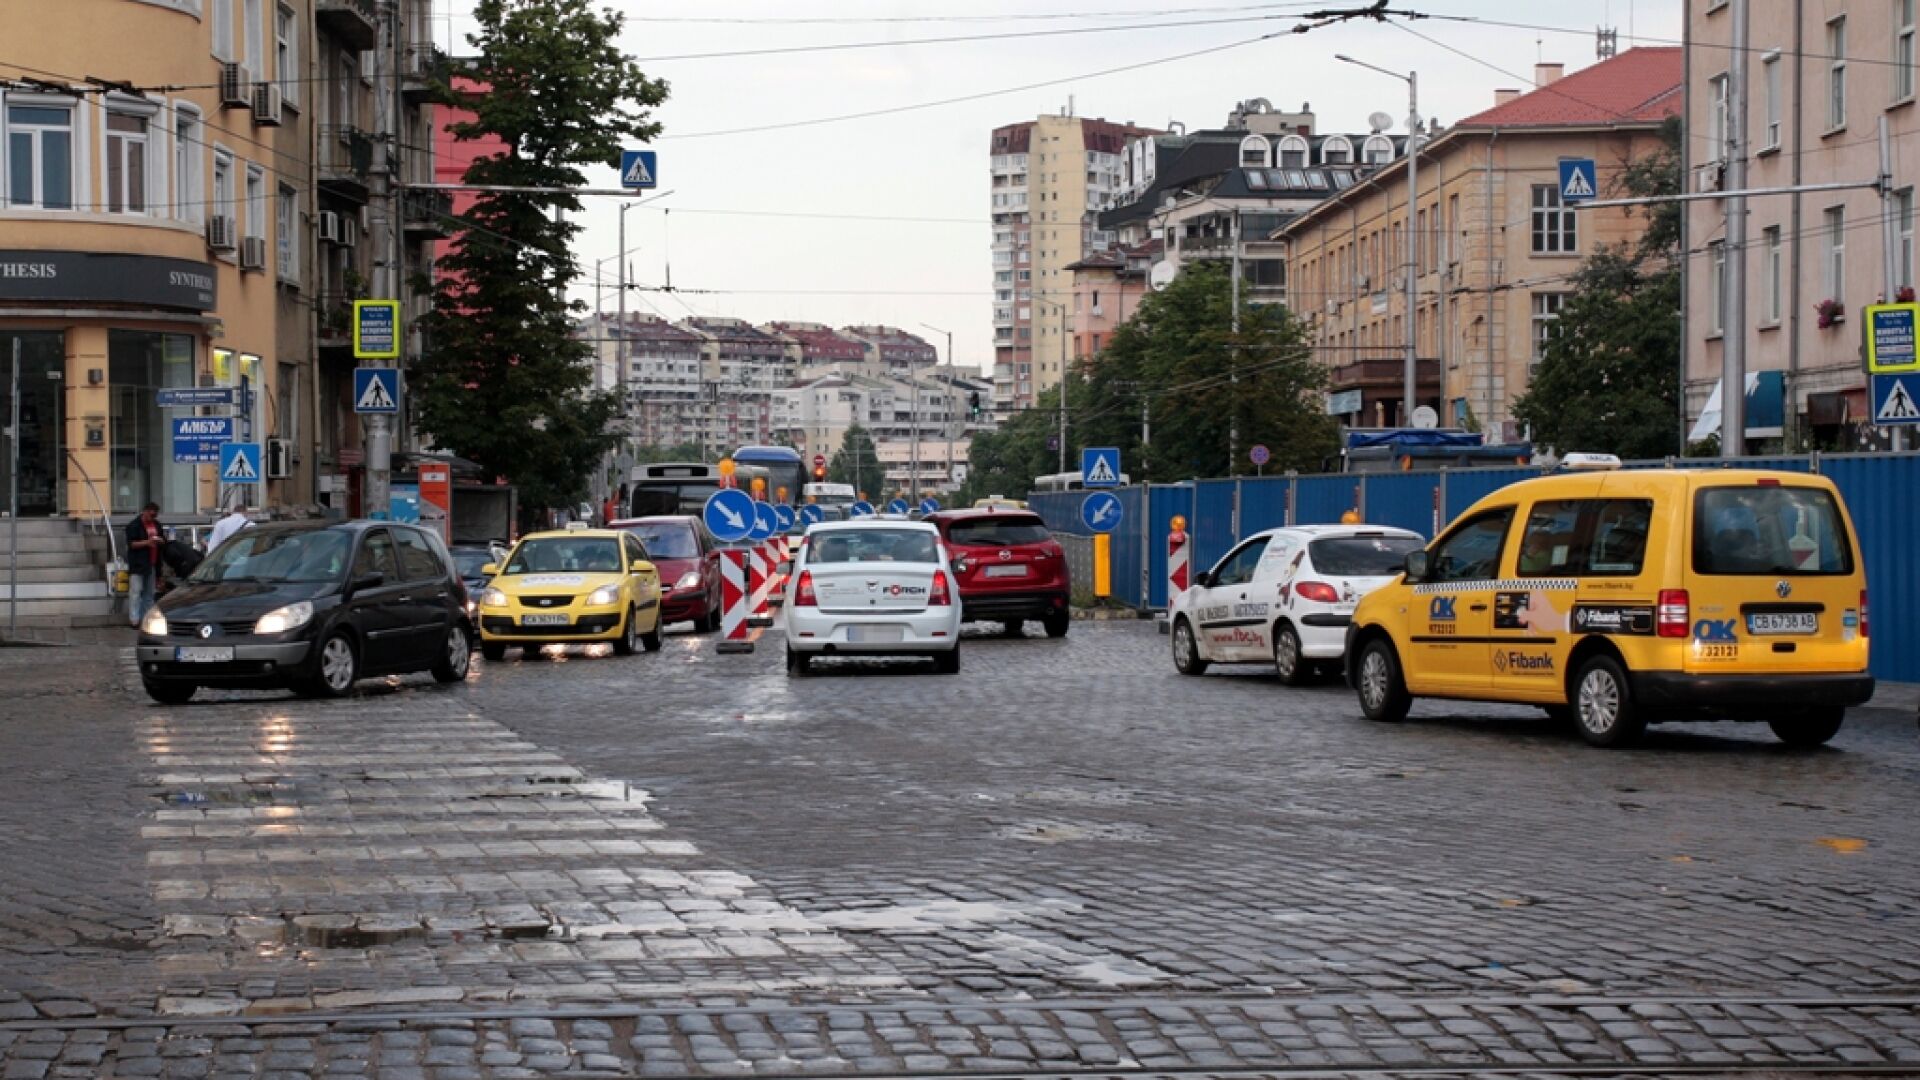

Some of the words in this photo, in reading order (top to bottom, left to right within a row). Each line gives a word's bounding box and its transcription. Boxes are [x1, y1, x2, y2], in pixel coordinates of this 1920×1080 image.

[0, 263, 57, 278] HESIS
[1587, 609, 1621, 624] Fibank
[1755, 615, 1769, 629] CB
[1771, 615, 1799, 629] 6738
[1692, 618, 1738, 642] OK
[1508, 650, 1554, 670] Fibank
